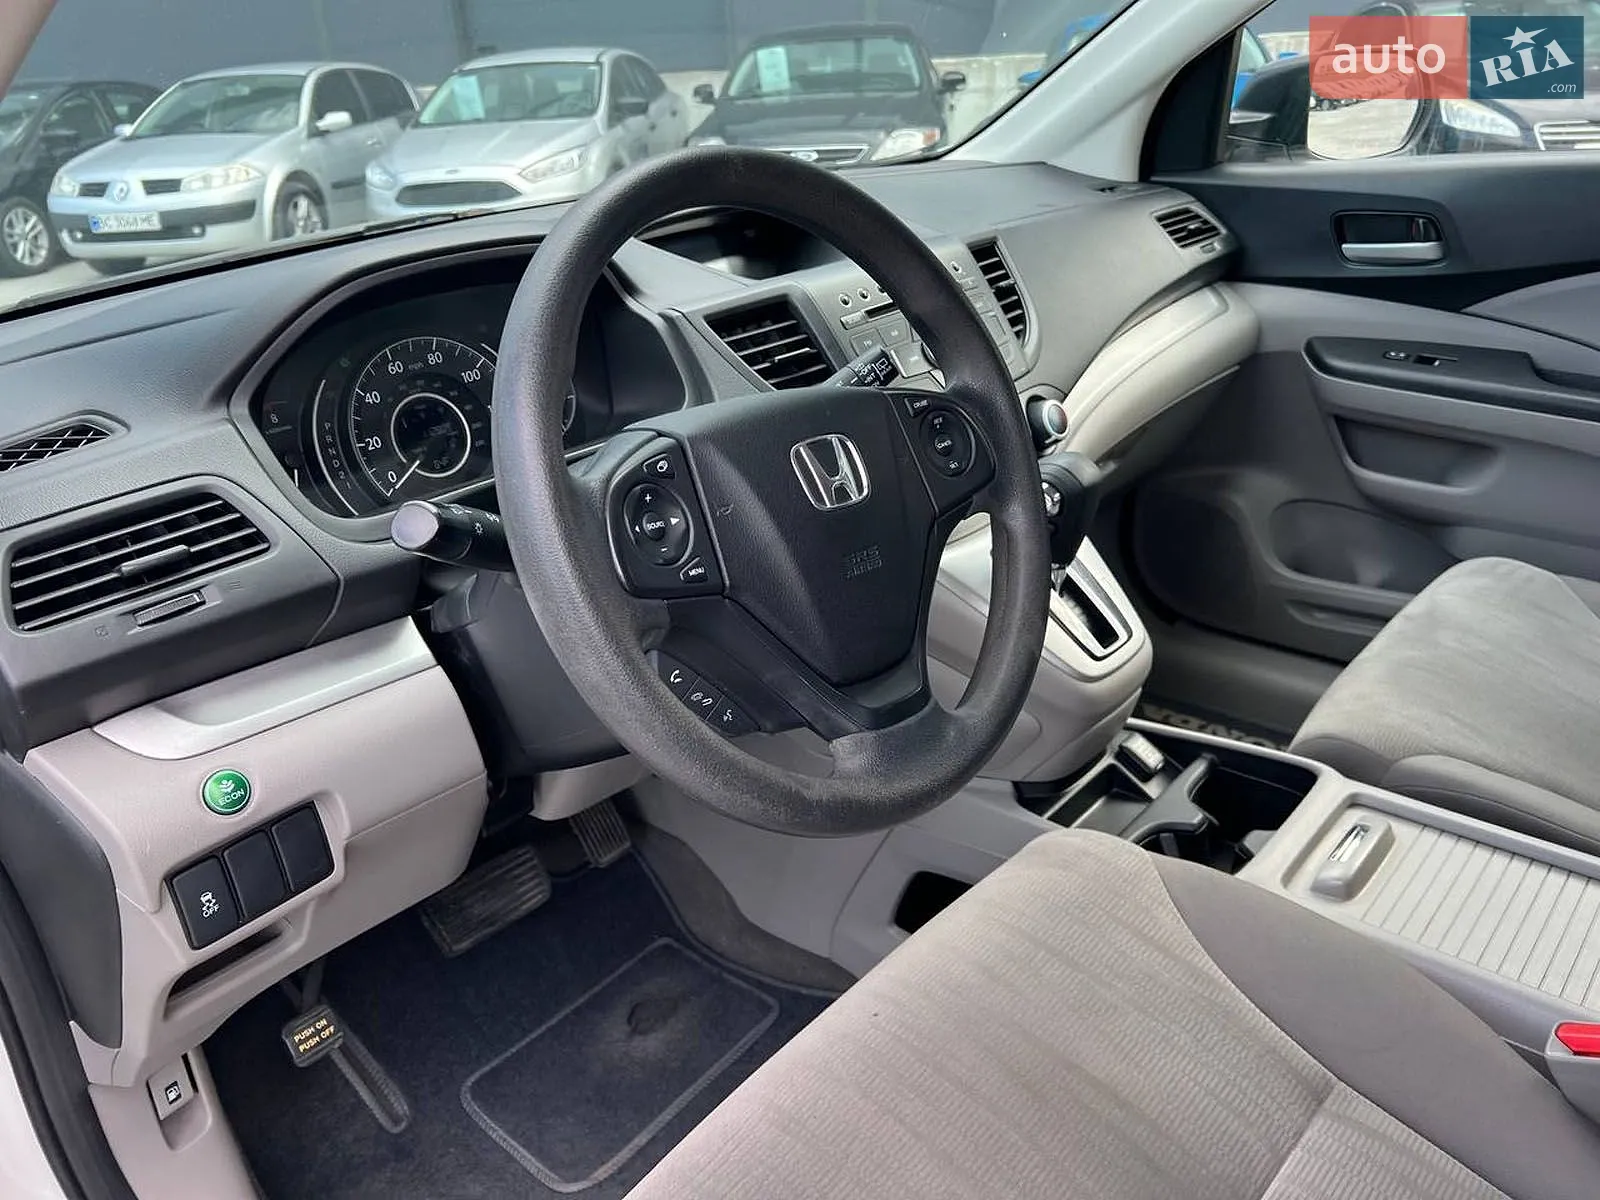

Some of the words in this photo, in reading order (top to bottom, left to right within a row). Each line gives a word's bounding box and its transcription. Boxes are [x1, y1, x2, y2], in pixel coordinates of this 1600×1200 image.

[427, 351, 443, 366] 80
[388, 361, 404, 375] 60
[461, 368, 481, 383] 100
[364, 391, 381, 405] 40
[270, 413, 279, 424] 8
[365, 436, 381, 451] 20
[388, 470, 397, 483] 0
[688, 566, 705, 577] MENU
[218, 789, 245, 806] ECON
[202, 904, 219, 918] OFF
[293, 1026, 315, 1043] PUSH
[315, 1018, 328, 1030] ON
[298, 1035, 320, 1053] PUSH
[320, 1025, 335, 1039] OFF
